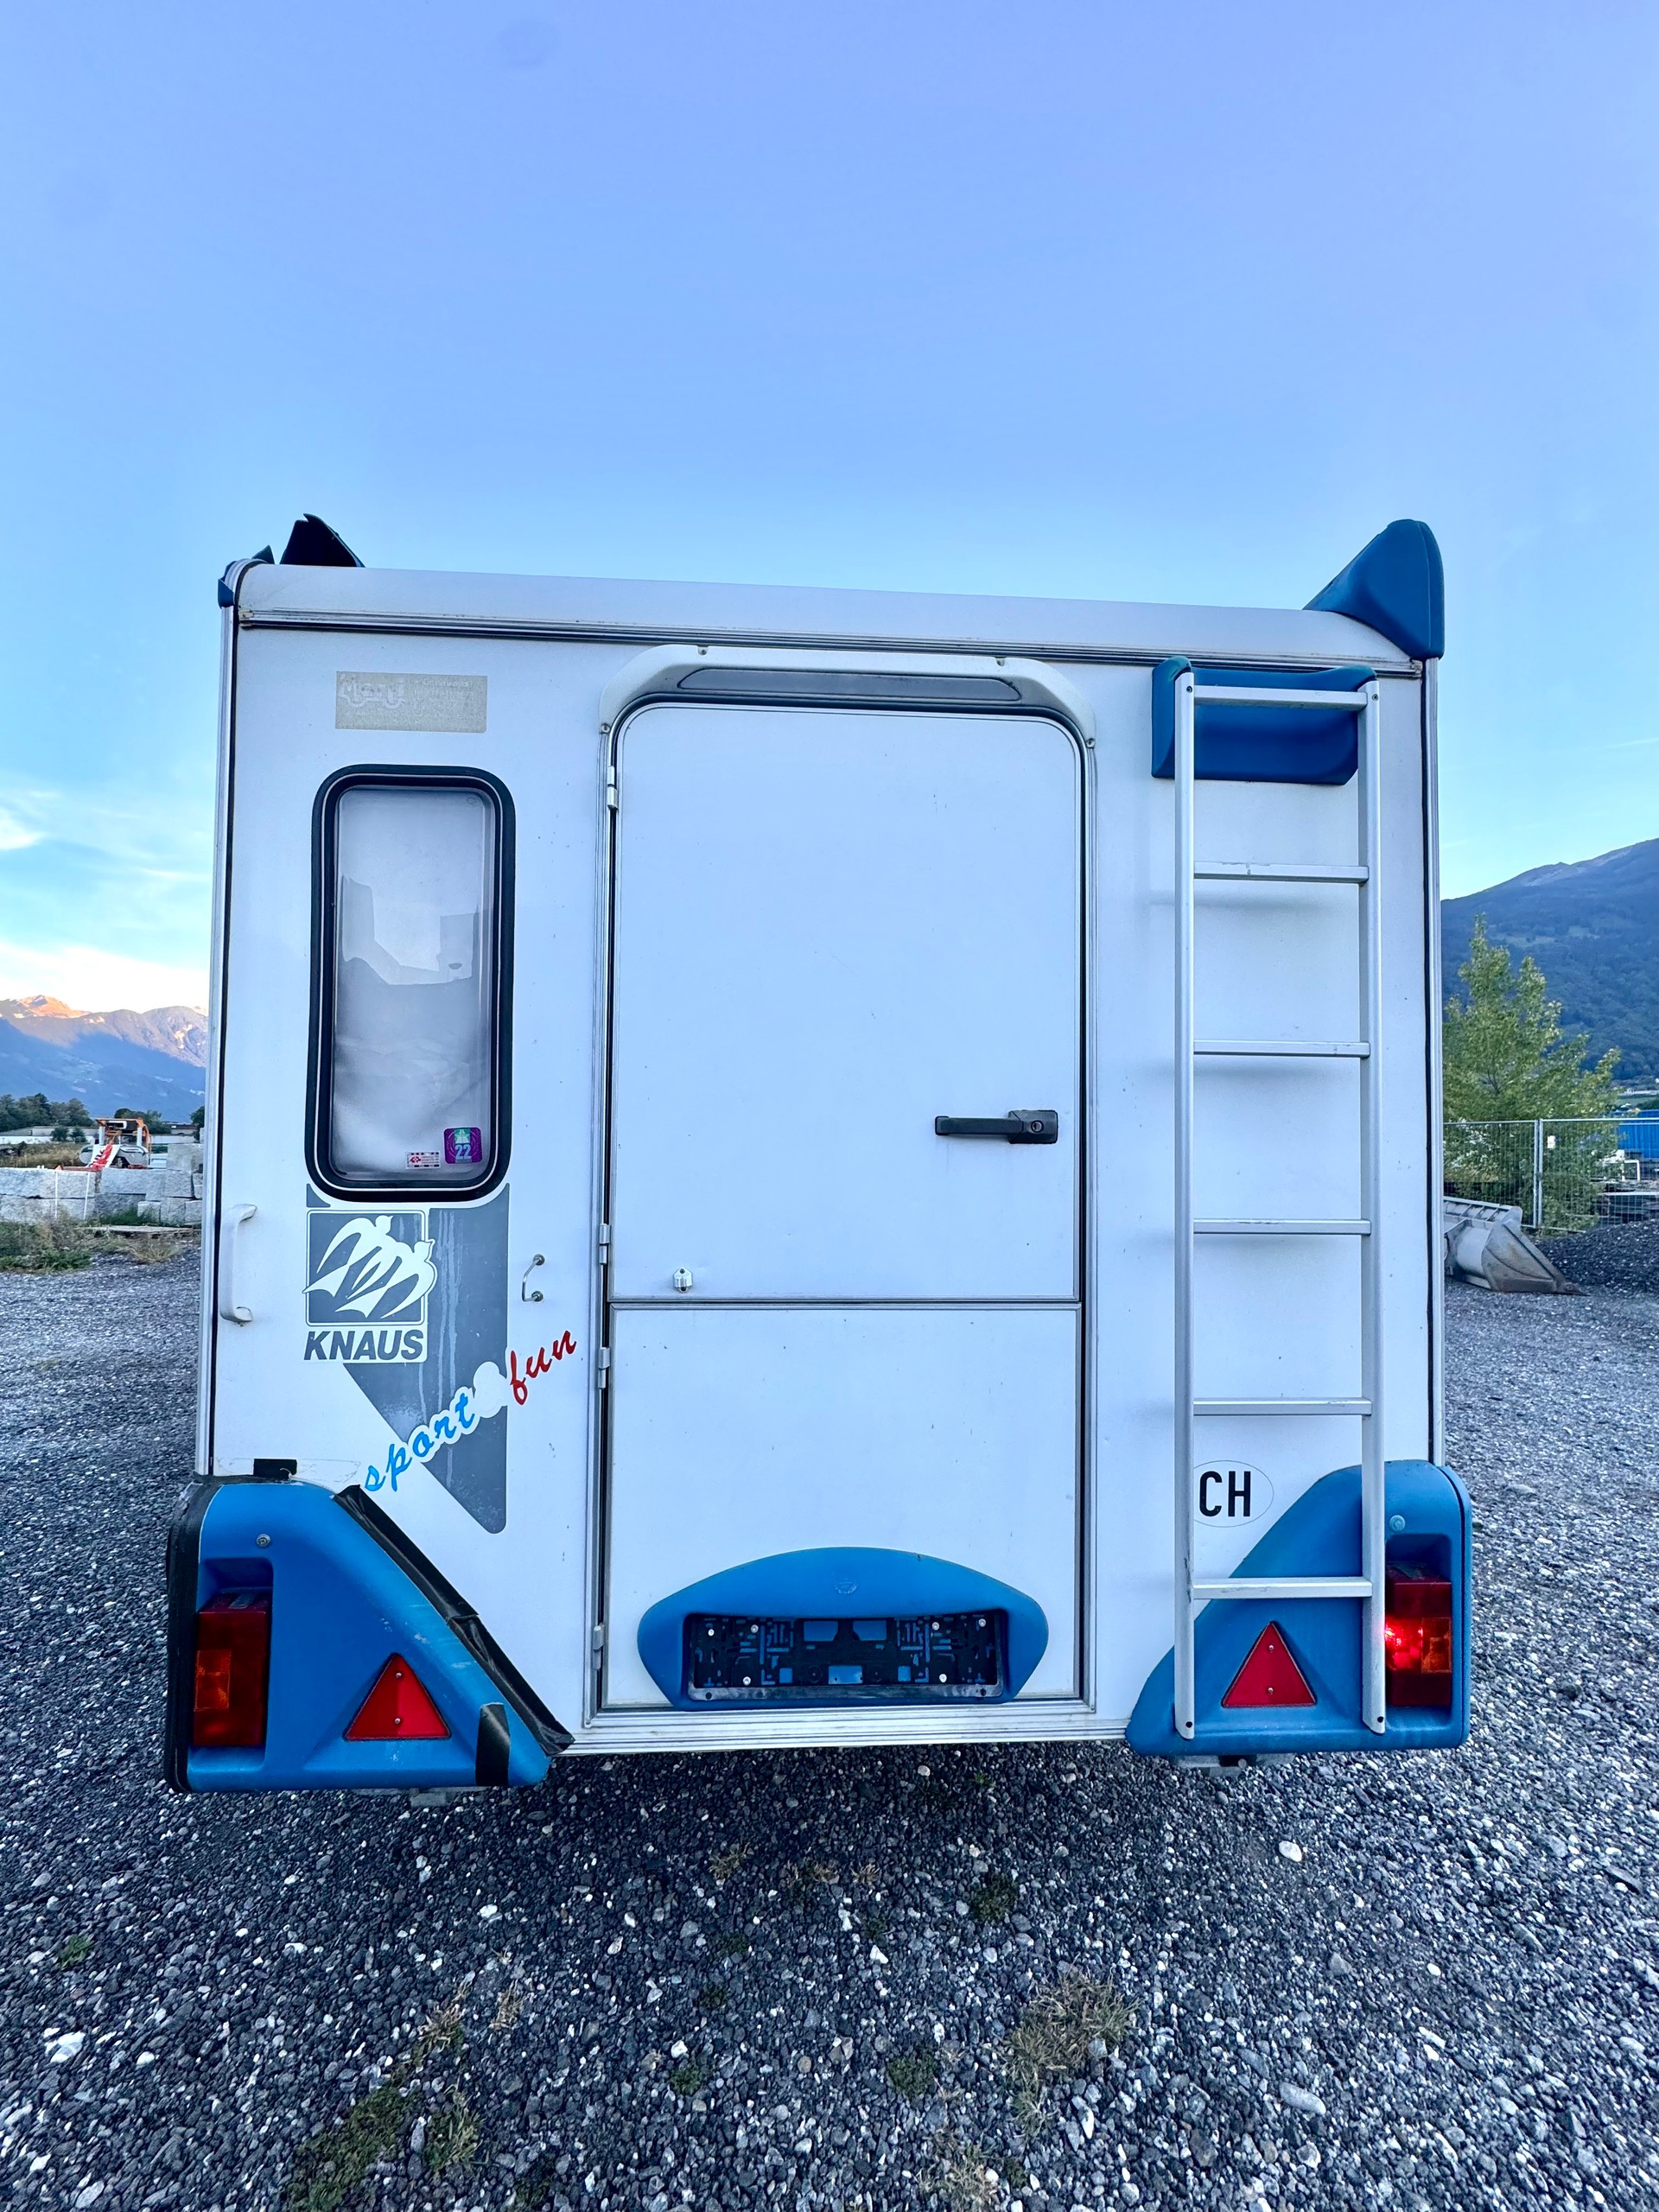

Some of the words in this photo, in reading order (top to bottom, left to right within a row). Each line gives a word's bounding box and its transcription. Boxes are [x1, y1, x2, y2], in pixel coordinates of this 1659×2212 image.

[454, 1144, 471, 1160] 22
[304, 1330, 423, 1361] KNAUS
[364, 1392, 475, 1492] sport
[509, 1330, 577, 1406] fun
[1199, 1471, 1251, 1517] CH
